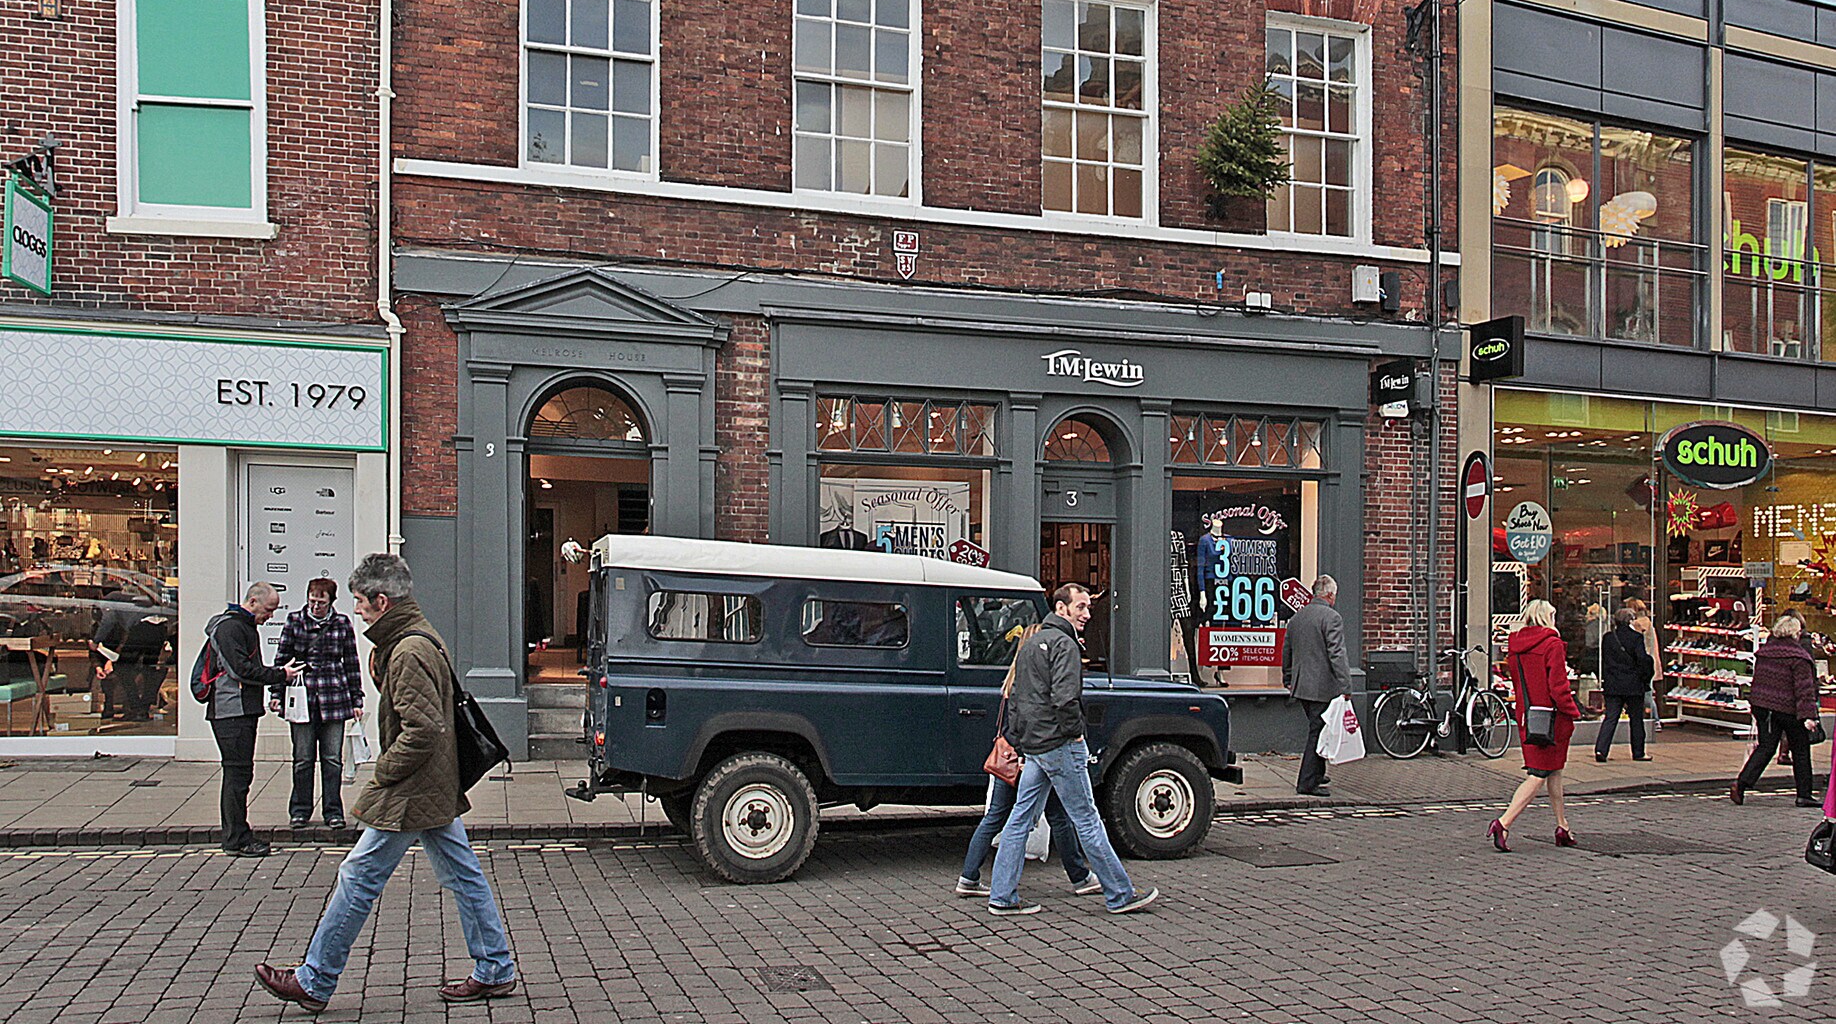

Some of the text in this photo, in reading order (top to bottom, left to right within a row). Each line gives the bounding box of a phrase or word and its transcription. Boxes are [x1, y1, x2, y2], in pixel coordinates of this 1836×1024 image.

[13, 225, 46, 258] CLOGGS
[1723, 220, 1820, 282] huh
[531, 347, 646, 362] MELROSE HOUSE
[1478, 342, 1505, 355] schuh
[217, 379, 366, 410] EST. 1979
[486, 442, 495, 457] 3
[1677, 435, 1757, 467] schuh
[861, 487, 960, 514] Seasonal Offer
[1066, 491, 1077, 506] 3
[1201, 503, 1288, 530] Seasonal Offer
[1520, 504, 1538, 520] Buy
[1754, 503, 1836, 537] MENS
[1509, 517, 1549, 531] Shoes Now
[876, 525, 893, 554] 5
[895, 526, 945, 548] MEN'S
[1511, 535, 1546, 550] Get £10
[1215, 539, 1277, 578] 3 WOMEN'S
[1231, 555, 1277, 575] SHIRTS
[1213, 576, 1275, 622] £66
[1213, 634, 1271, 643] WOMEN'S SALE
[1209, 647, 1239, 662] 20%
